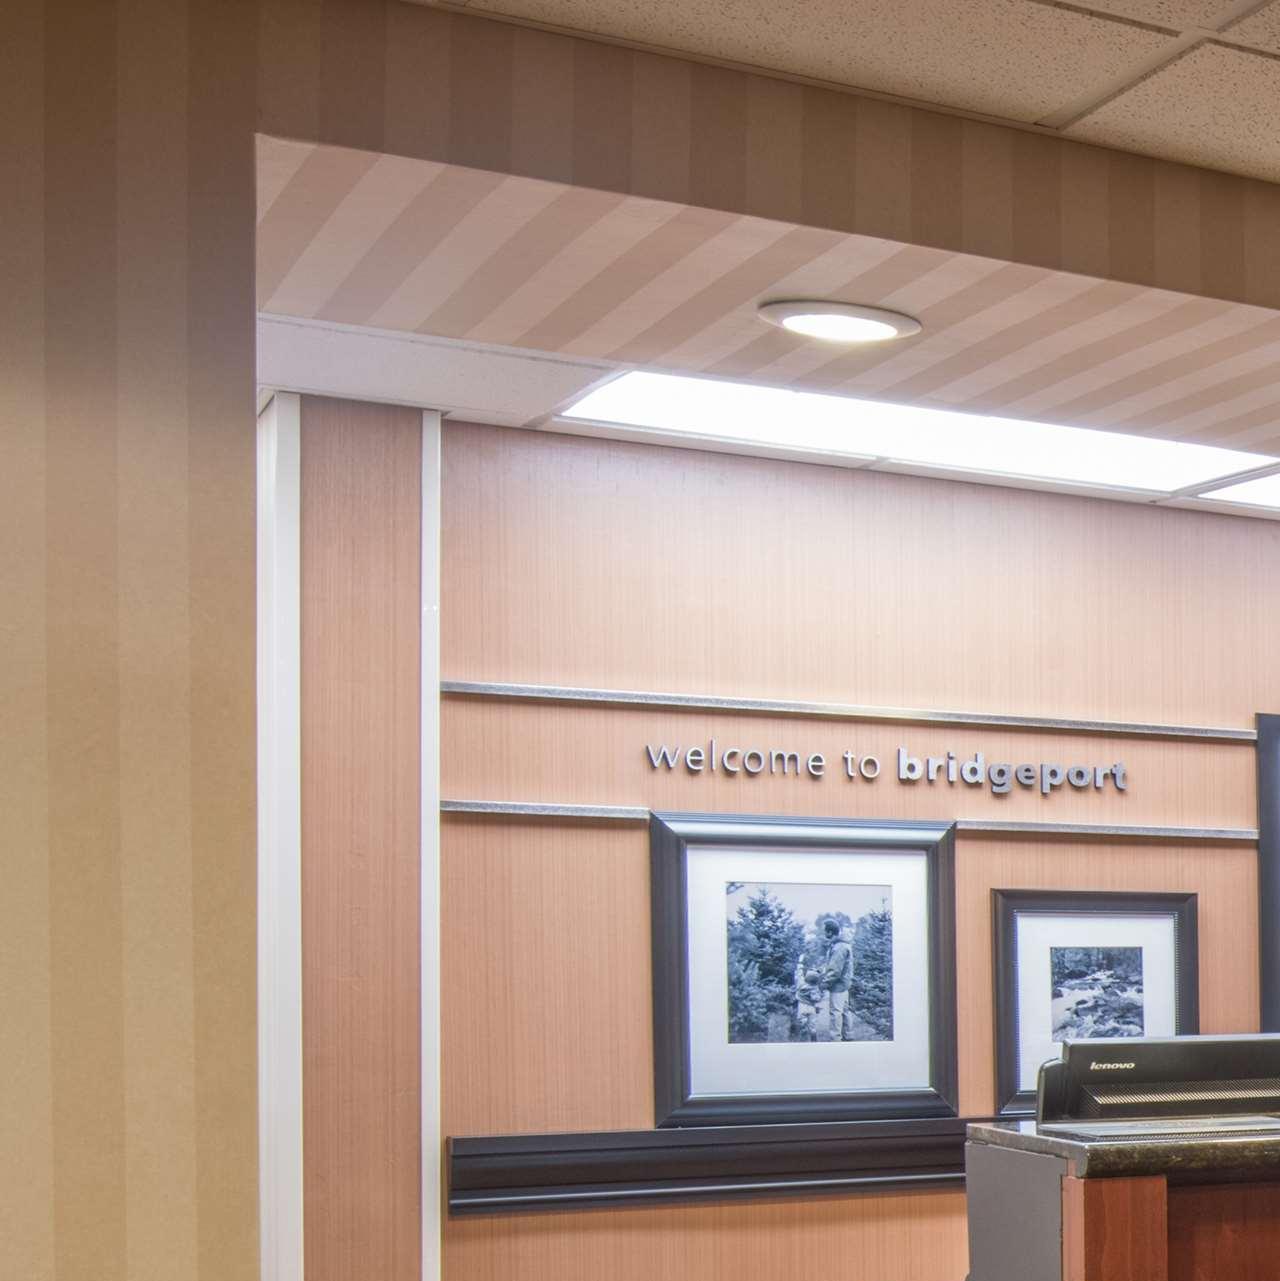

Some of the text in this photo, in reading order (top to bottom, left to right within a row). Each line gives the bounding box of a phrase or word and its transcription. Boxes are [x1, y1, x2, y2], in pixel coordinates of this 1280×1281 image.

[646, 738, 1128, 795] welcome to bridgeport
[1090, 1061, 1136, 1071] lenovo
